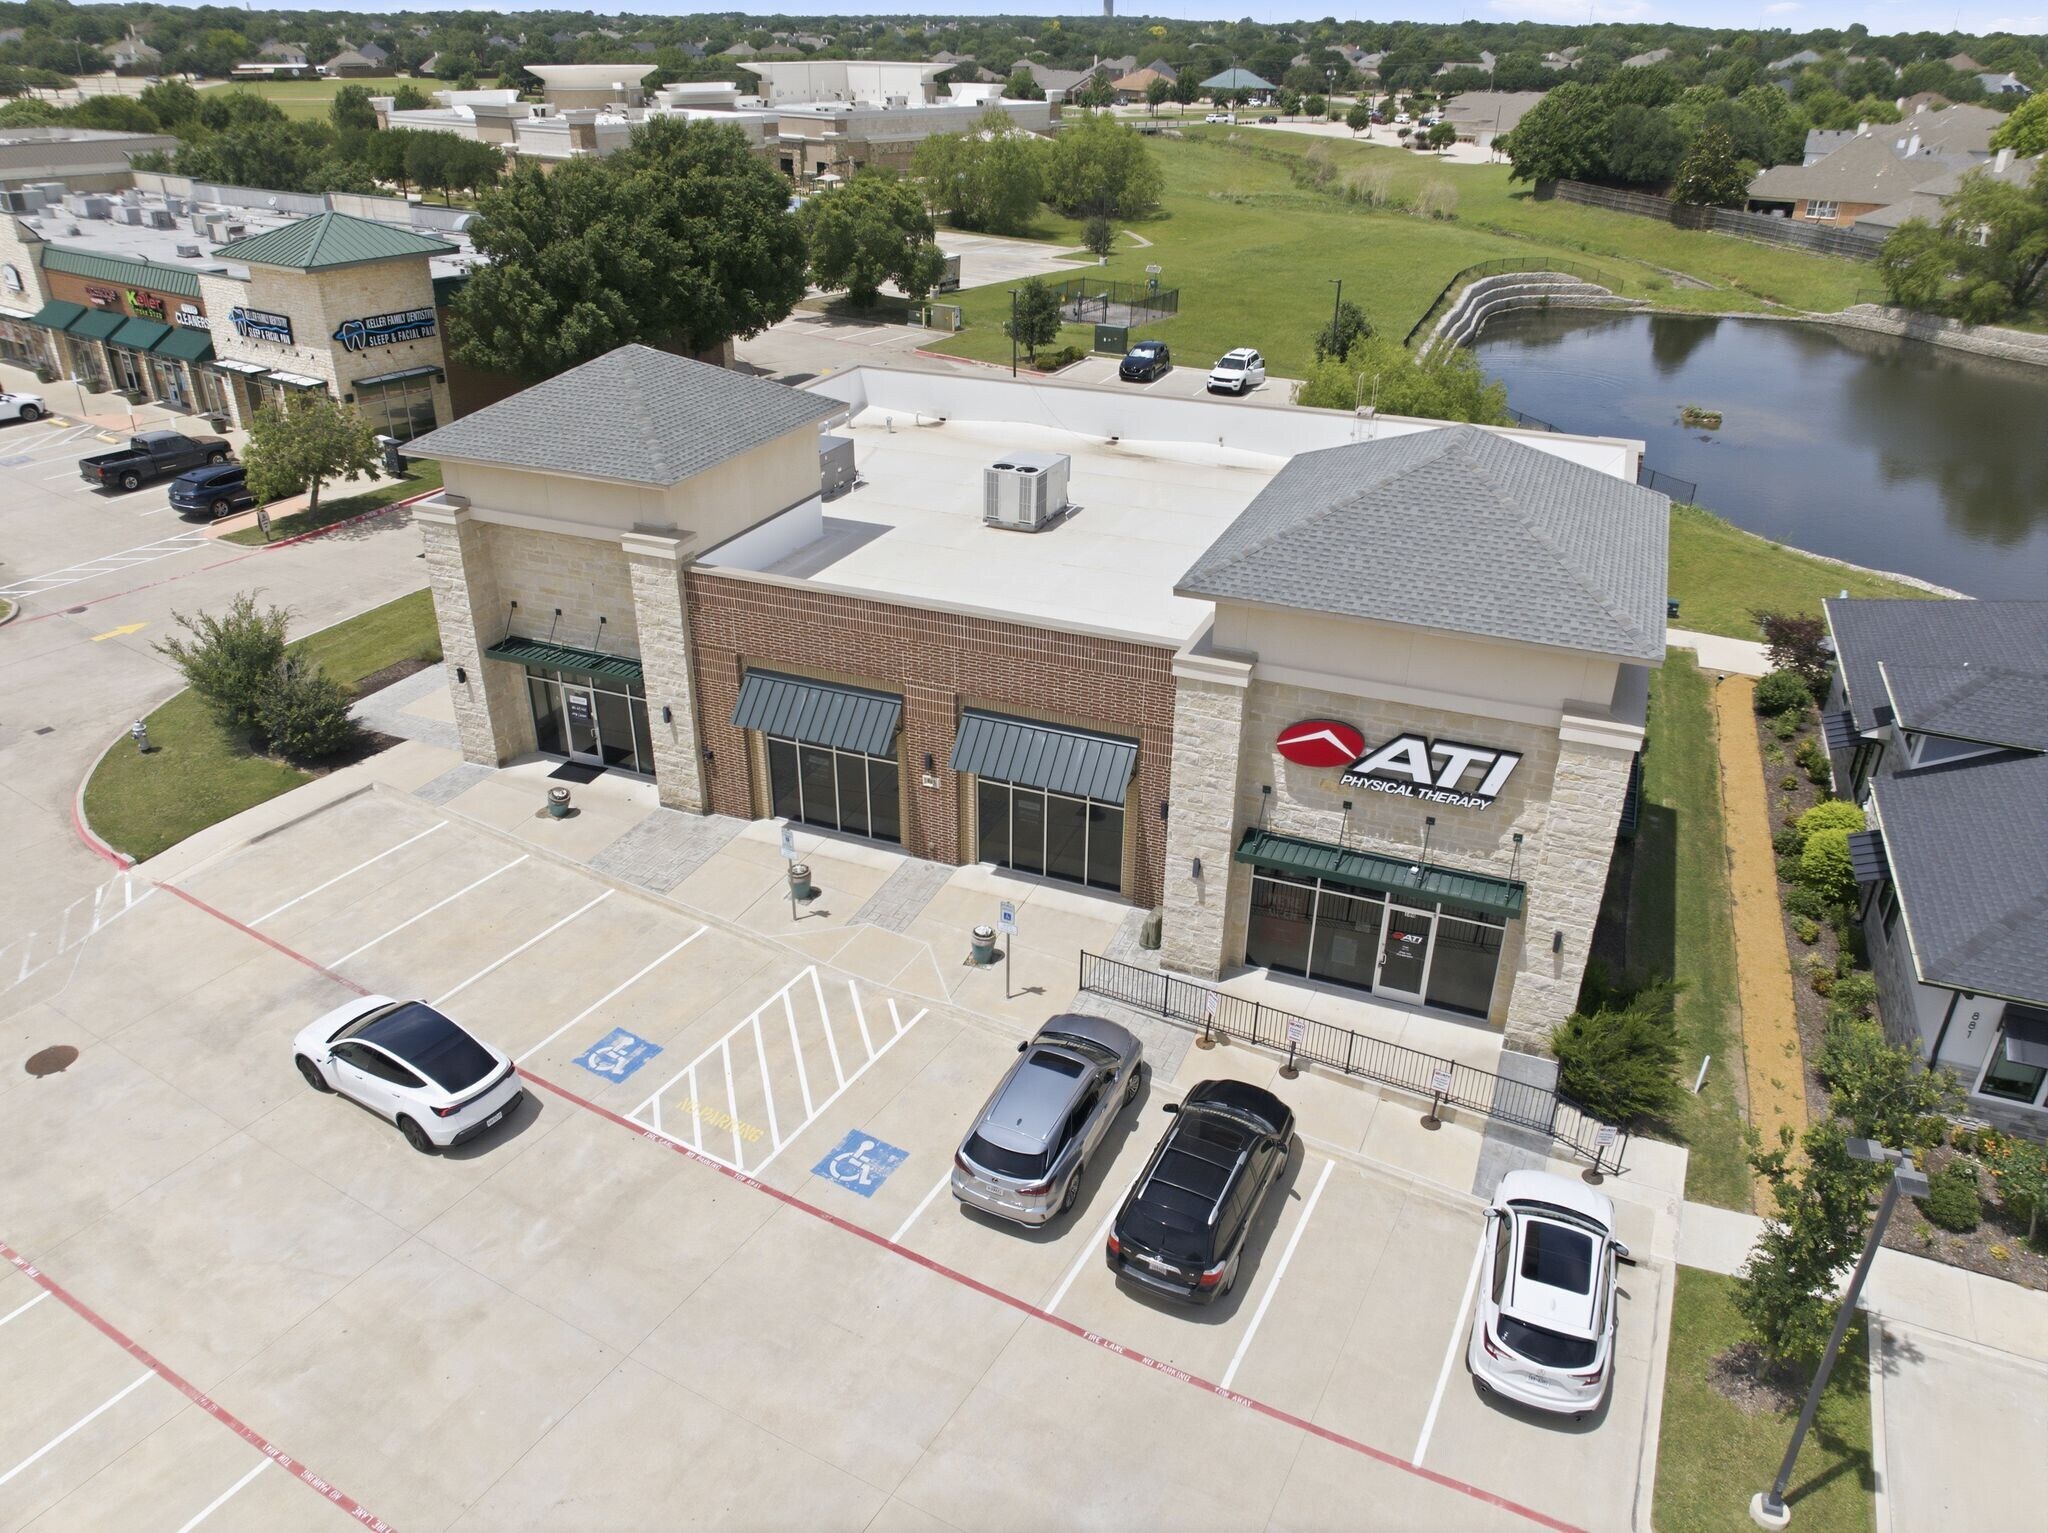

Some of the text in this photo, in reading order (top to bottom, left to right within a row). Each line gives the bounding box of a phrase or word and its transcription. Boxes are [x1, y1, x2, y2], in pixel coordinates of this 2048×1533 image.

[124, 288, 161, 311] Keller
[175, 311, 211, 330] CLEANERS
[366, 315, 387, 329] KELLER
[387, 312, 406, 325] FAMILY
[369, 335, 389, 347] SLEEP
[398, 328, 420, 341] FACIAL
[1350, 736, 1522, 798] ATI
[1340, 775, 1494, 811] PHYSICAL THERAPY
